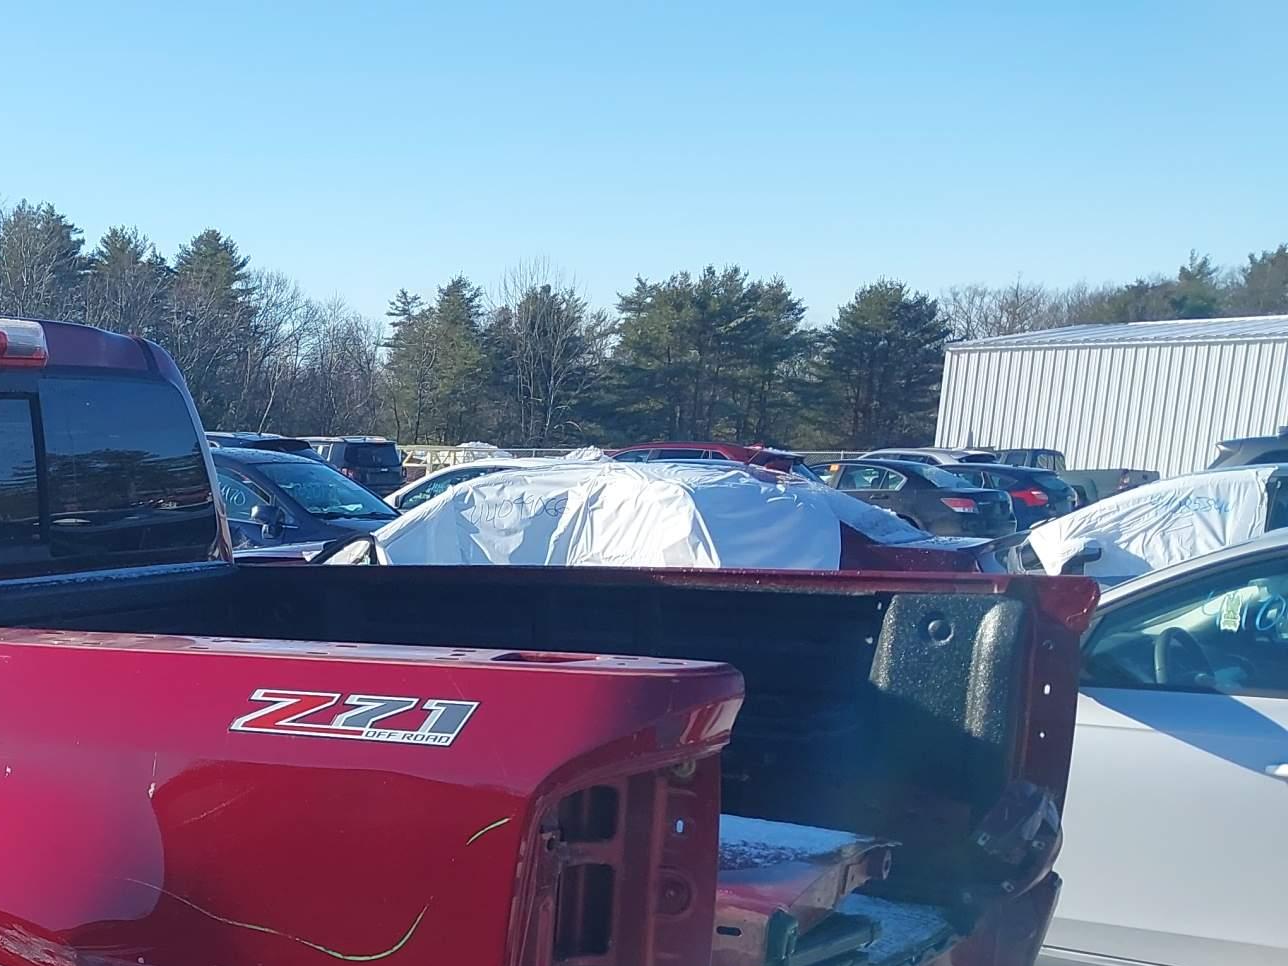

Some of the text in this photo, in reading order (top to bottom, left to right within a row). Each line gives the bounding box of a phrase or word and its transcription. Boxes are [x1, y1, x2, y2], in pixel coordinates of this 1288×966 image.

[229, 689, 481, 739] Z71
[365, 730, 451, 744] OFF ROAD
